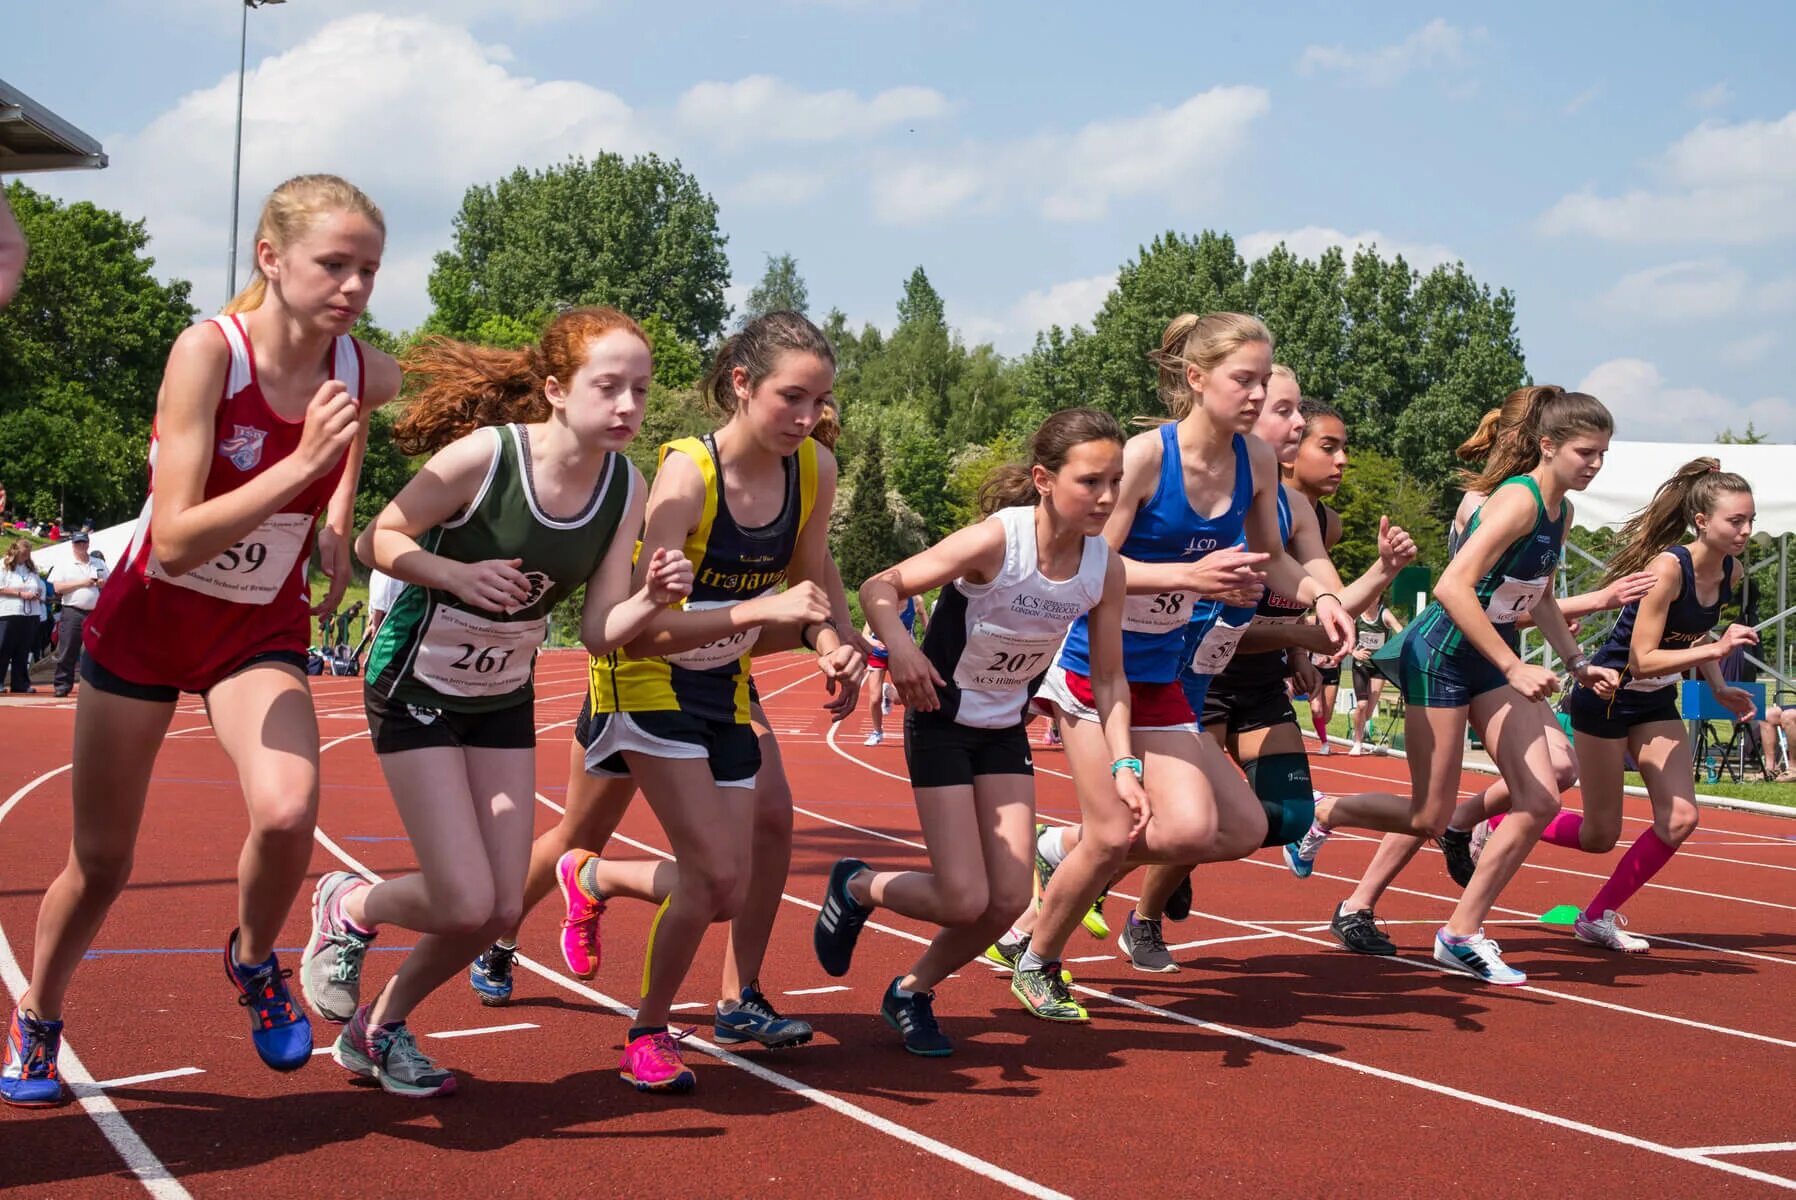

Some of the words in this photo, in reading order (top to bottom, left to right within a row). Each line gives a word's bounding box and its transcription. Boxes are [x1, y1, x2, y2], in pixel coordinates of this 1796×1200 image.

[1012, 594, 1041, 609] ACS
[1150, 593, 1184, 615] 58
[1011, 605, 1040, 617] LONDON
[449, 643, 516, 674] 261
[986, 652, 1045, 673] 207
[974, 676, 994, 684] ACS
